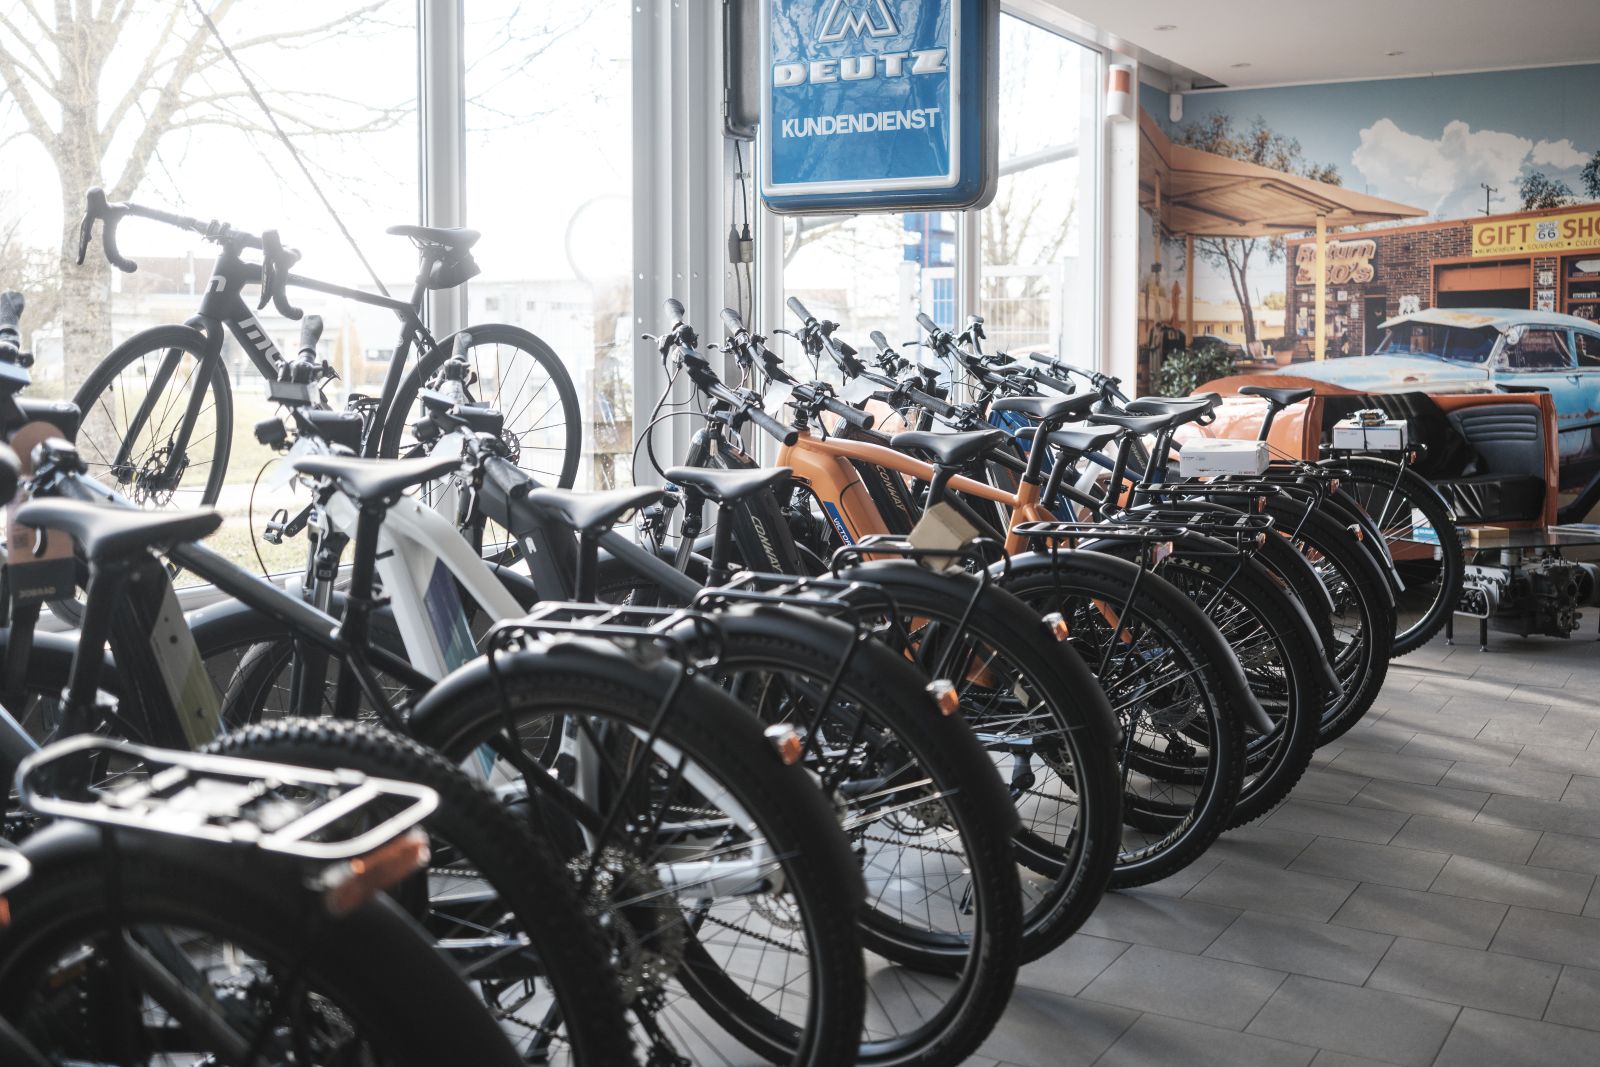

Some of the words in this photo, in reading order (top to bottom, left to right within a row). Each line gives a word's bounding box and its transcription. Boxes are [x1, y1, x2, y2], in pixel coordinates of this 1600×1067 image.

[773, 49, 947, 87] DEUTZ
[782, 108, 940, 138] KUNDENDIENST
[1478, 223, 1530, 246] GIFT
[1538, 230, 1556, 240] 66
[876, 464, 906, 512] CONWAY
[751, 515, 783, 574] CONWAY
[1135, 555, 1212, 573] MXXIS
[1155, 808, 1194, 852] CONWAY
